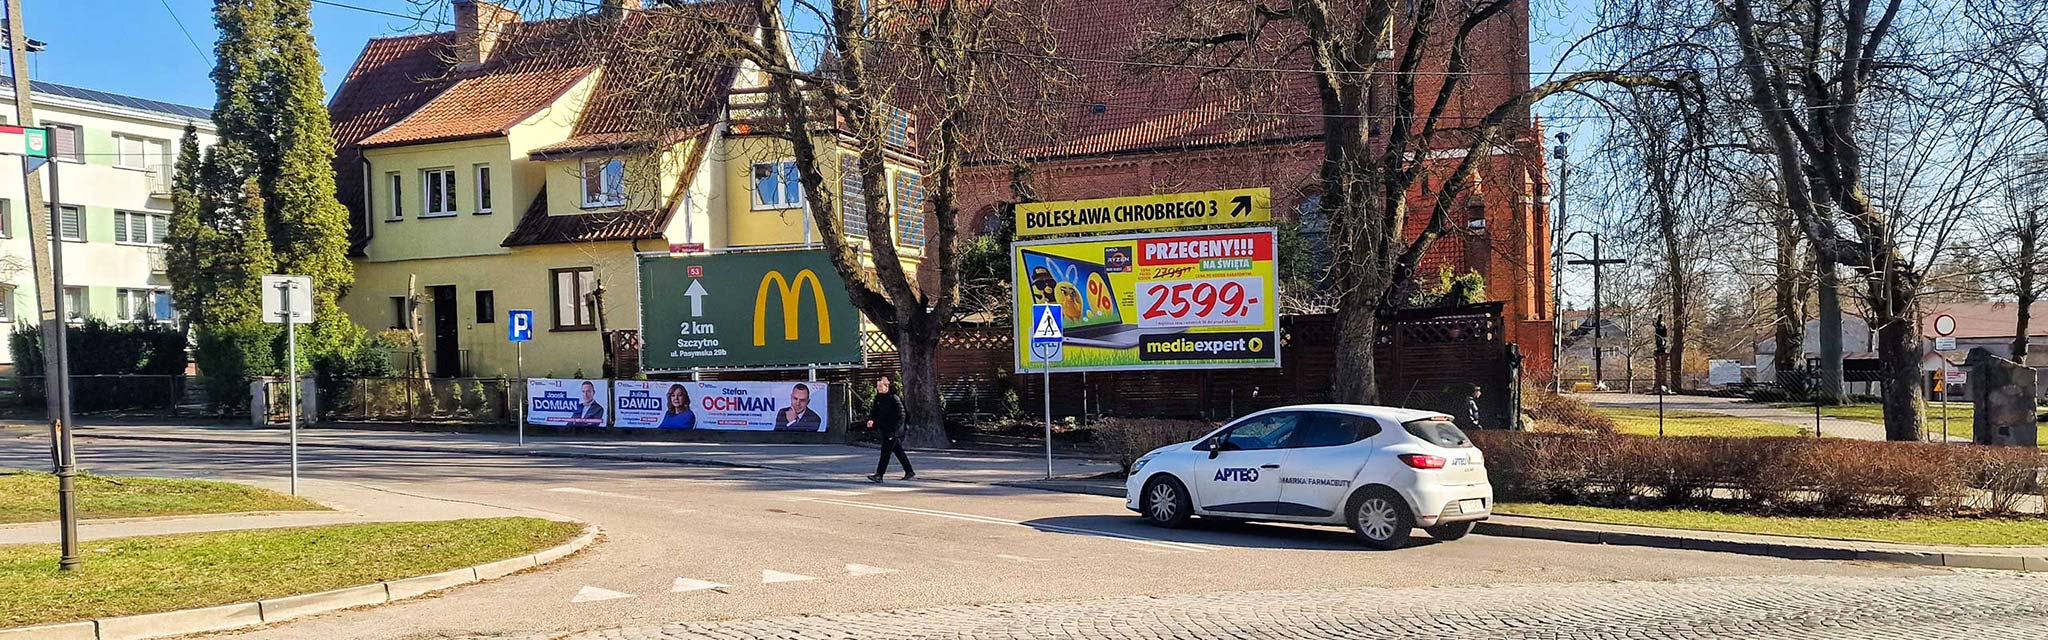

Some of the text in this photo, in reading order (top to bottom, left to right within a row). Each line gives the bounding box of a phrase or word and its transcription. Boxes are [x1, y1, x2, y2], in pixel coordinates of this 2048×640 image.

[1026, 200, 1218, 229] BOLESŁAWA CHROBREGO 3
[1145, 238, 1254, 260] PRZECENY!!!
[1202, 259, 1250, 270] NA ŚWIĘTA
[514, 313, 528, 337] P
[680, 321, 714, 335] 2 km
[677, 338, 719, 349] Szczytno
[1147, 338, 1246, 354] mediaexpert
[680, 350, 713, 358] Pasymska
[721, 387, 748, 396] Stefan
[535, 399, 578, 411] DOMIAN
[621, 398, 660, 409] DAWID
[702, 396, 775, 412] OCHMAN
